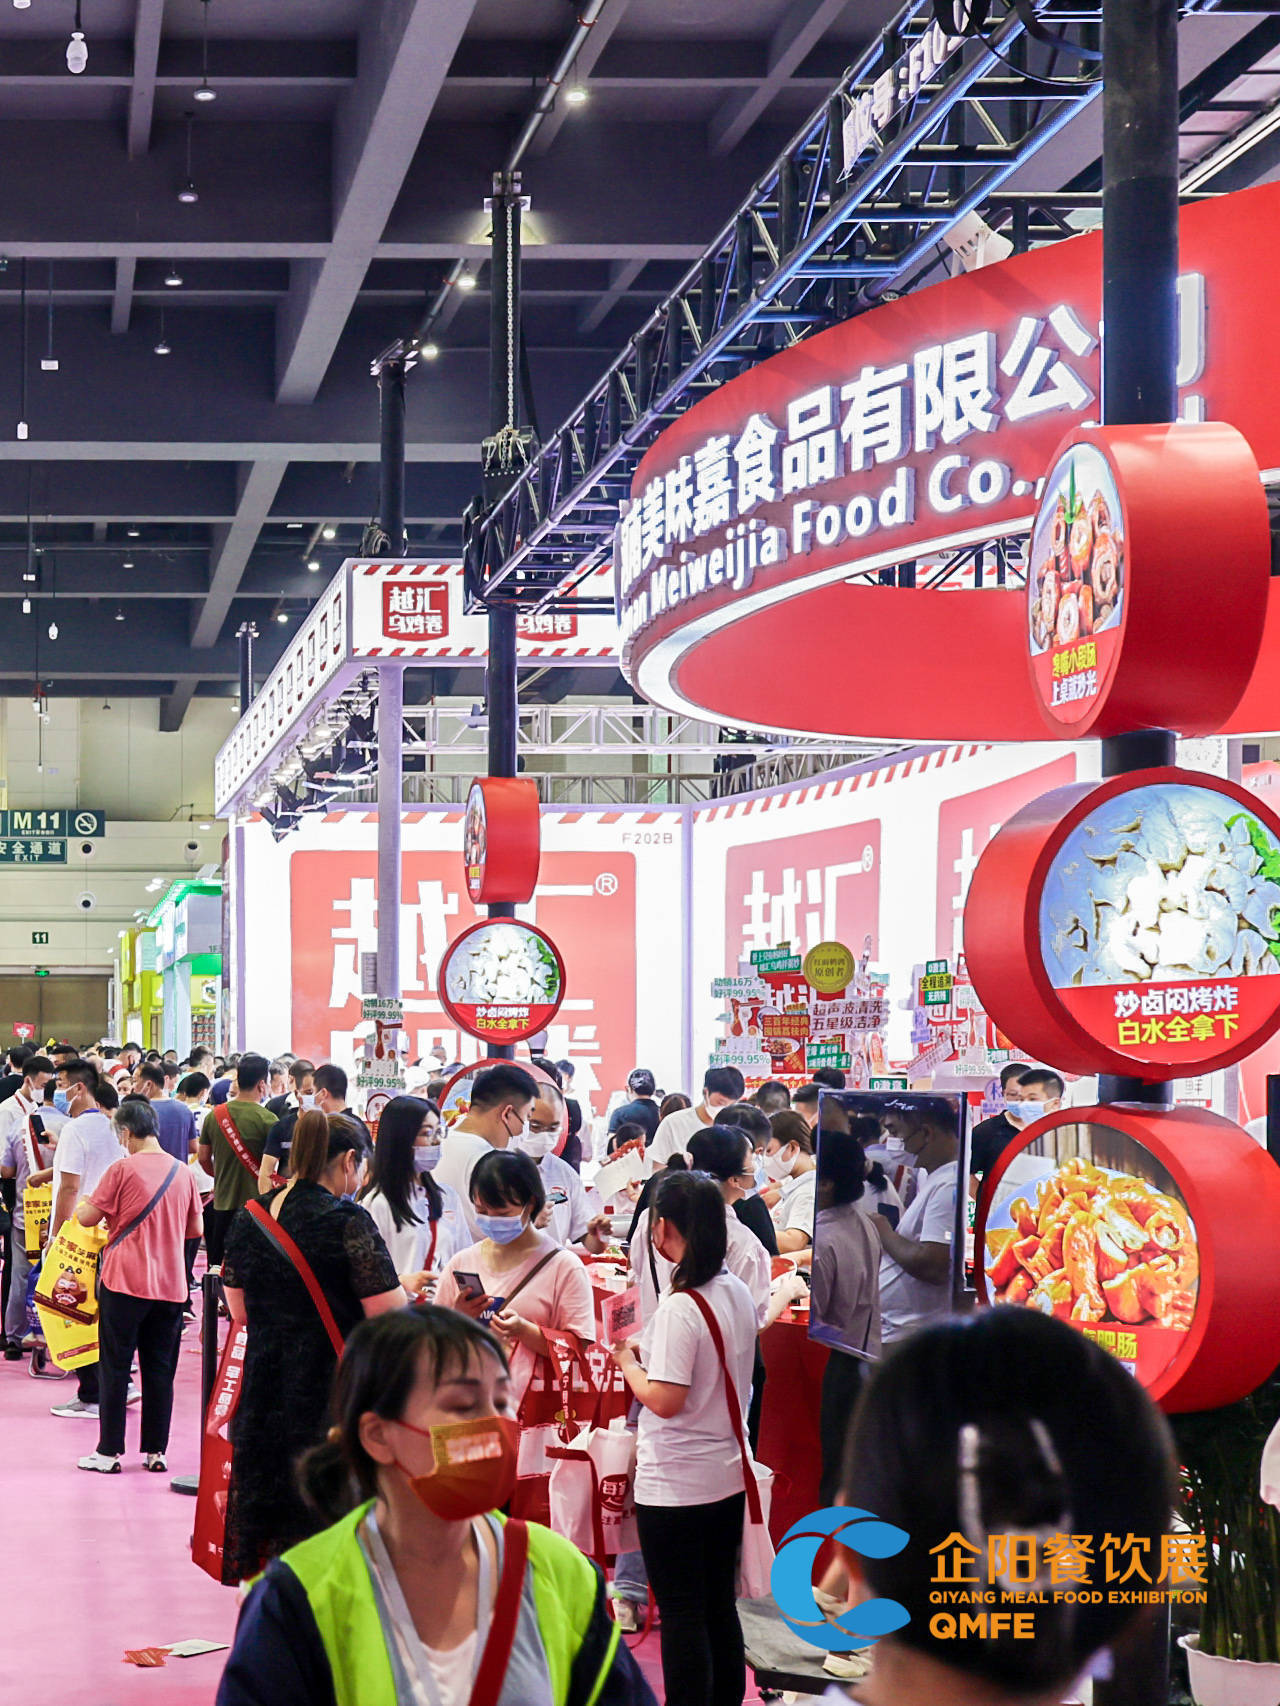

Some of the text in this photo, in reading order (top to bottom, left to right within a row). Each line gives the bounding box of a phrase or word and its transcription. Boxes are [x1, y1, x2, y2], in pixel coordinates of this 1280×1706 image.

[792, 466, 914, 553] Food
[388, 585, 446, 614] 越汇
[622, 832, 673, 845] F202B
[34, 933, 47, 943] 11
[476, 1018, 530, 1030] 白水全拿下
[1117, 1013, 1240, 1046] 白水全拿下
